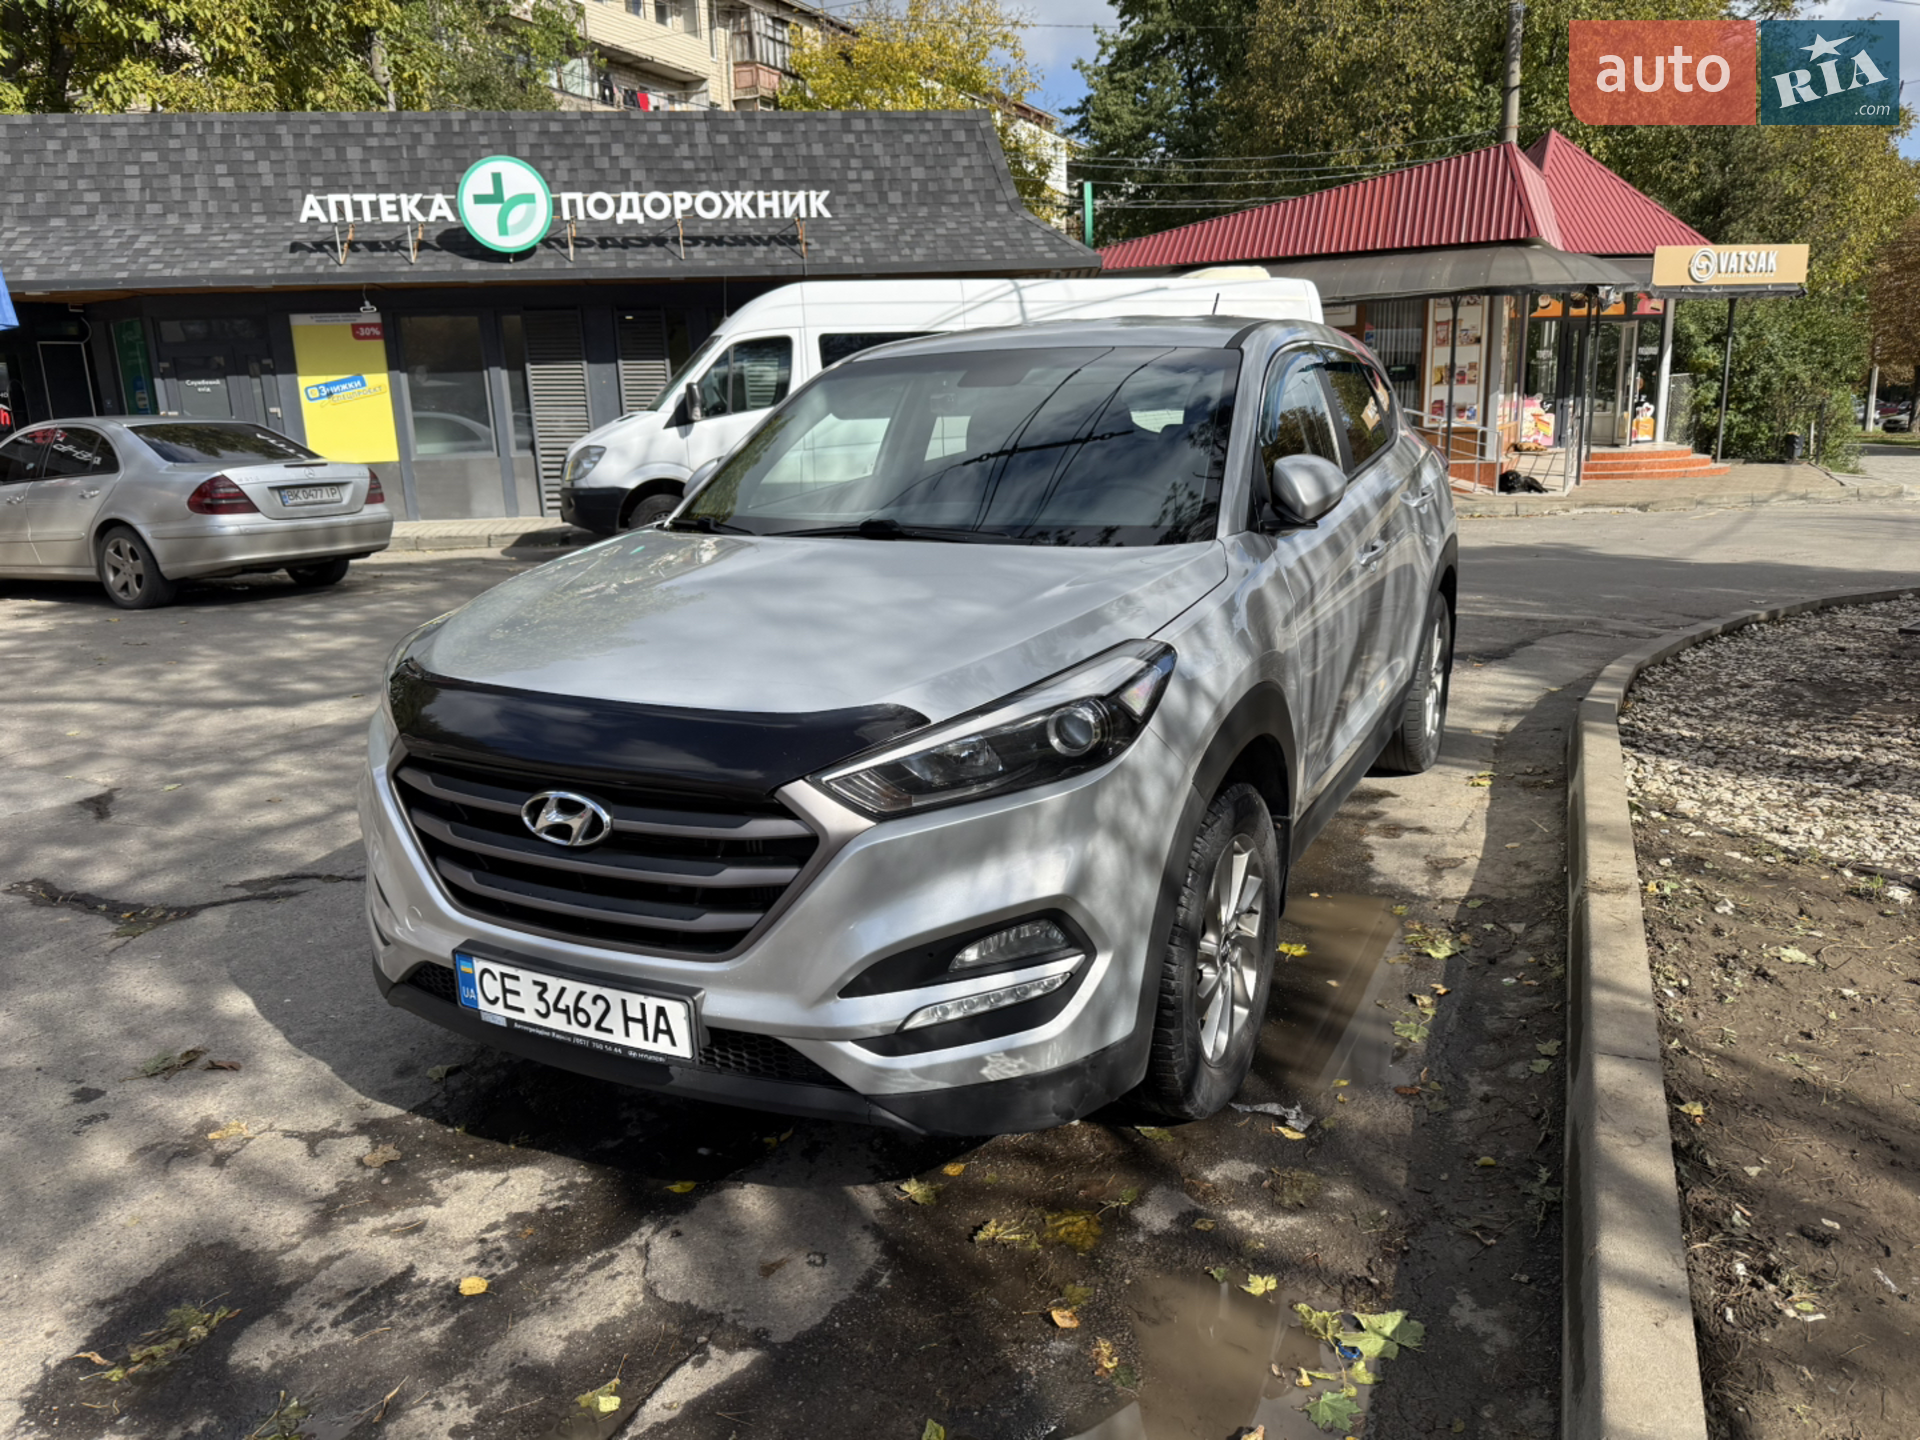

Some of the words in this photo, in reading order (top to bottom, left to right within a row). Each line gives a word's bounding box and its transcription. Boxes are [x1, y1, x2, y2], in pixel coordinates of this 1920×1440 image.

[299, 193, 457, 223] АПТЕКА
[560, 190, 833, 225] ПОДОРОЖНИК
[1717, 250, 1778, 274] VATSAK
[355, 327, 381, 337] -30%
[302, 488, 324, 500] 0477
[462, 986, 477, 1001] UA
[478, 967, 525, 1014] CE
[532, 980, 614, 1035] 3462
[621, 998, 678, 1047] HA
